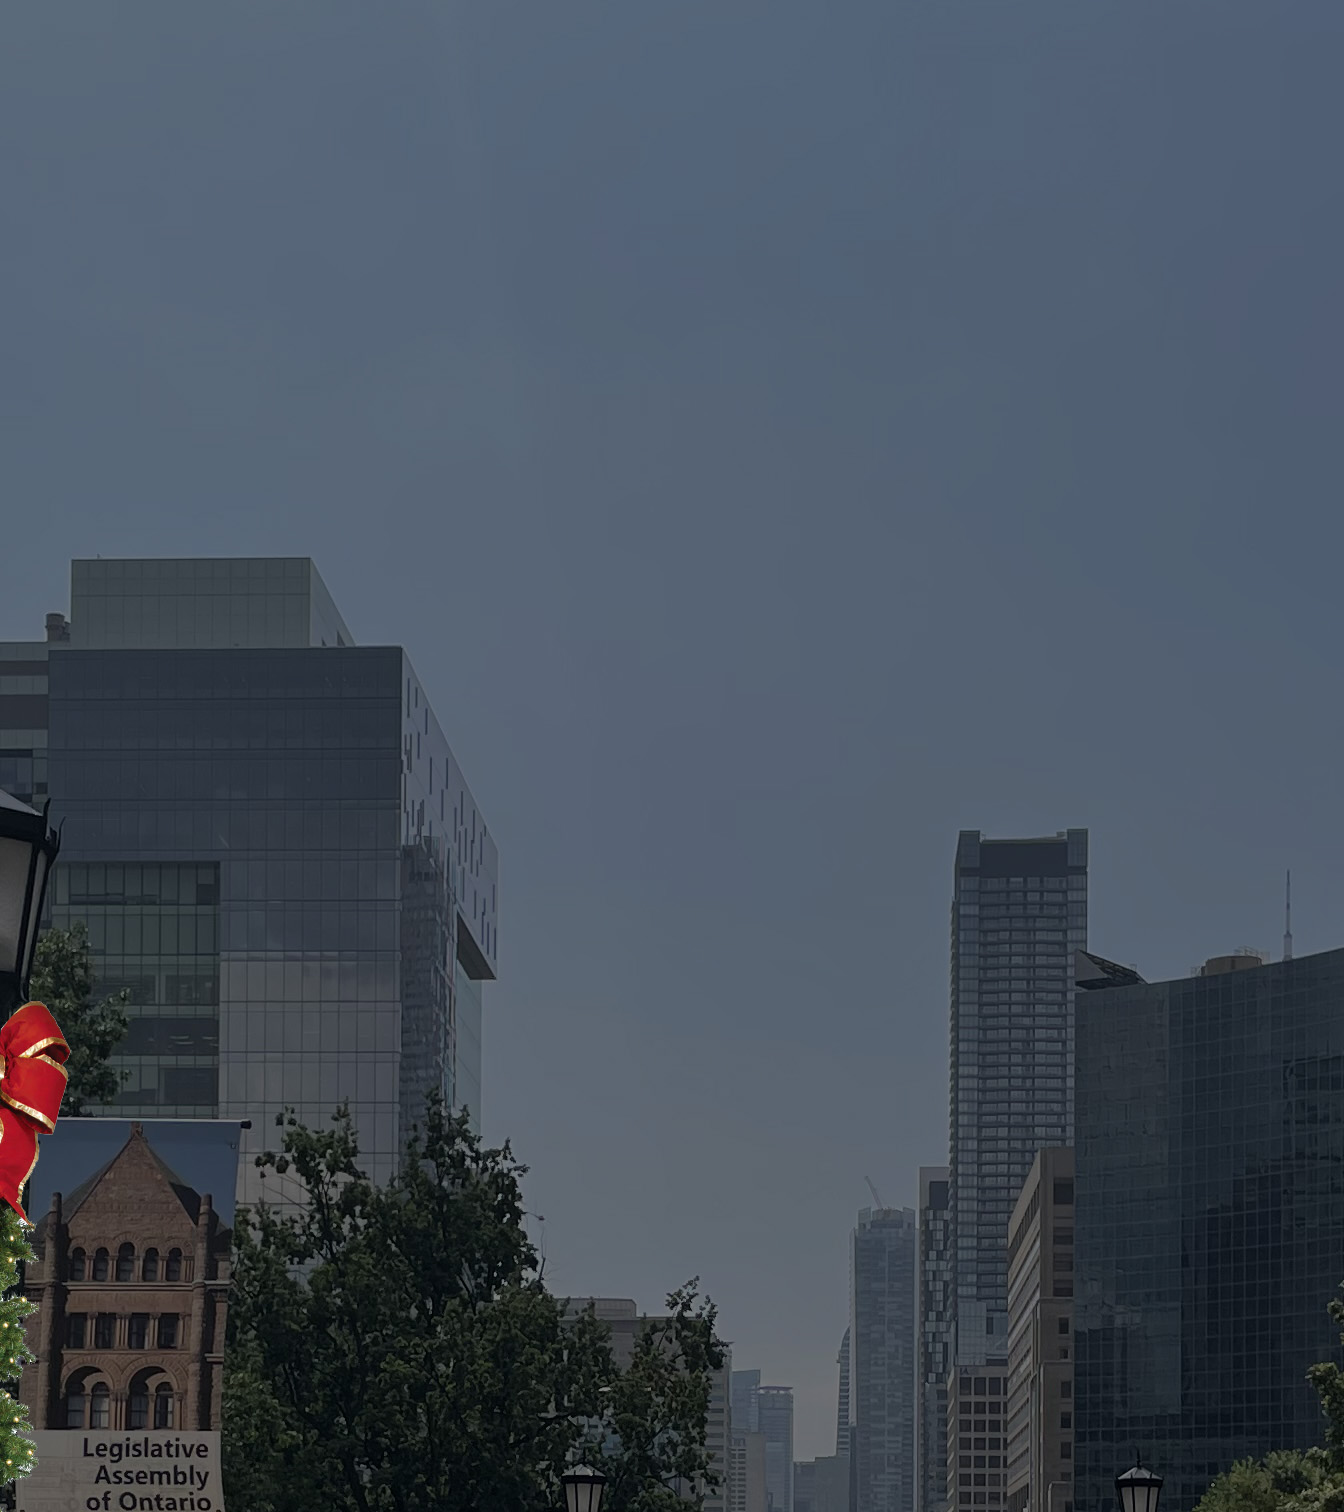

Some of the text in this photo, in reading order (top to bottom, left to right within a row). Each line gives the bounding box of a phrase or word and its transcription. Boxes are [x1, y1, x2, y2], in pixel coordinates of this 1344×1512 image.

[83, 1437, 209, 1463] Legislative
[94, 1464, 209, 1491] Assembly
[86, 1490, 212, 1511] of Ontario
